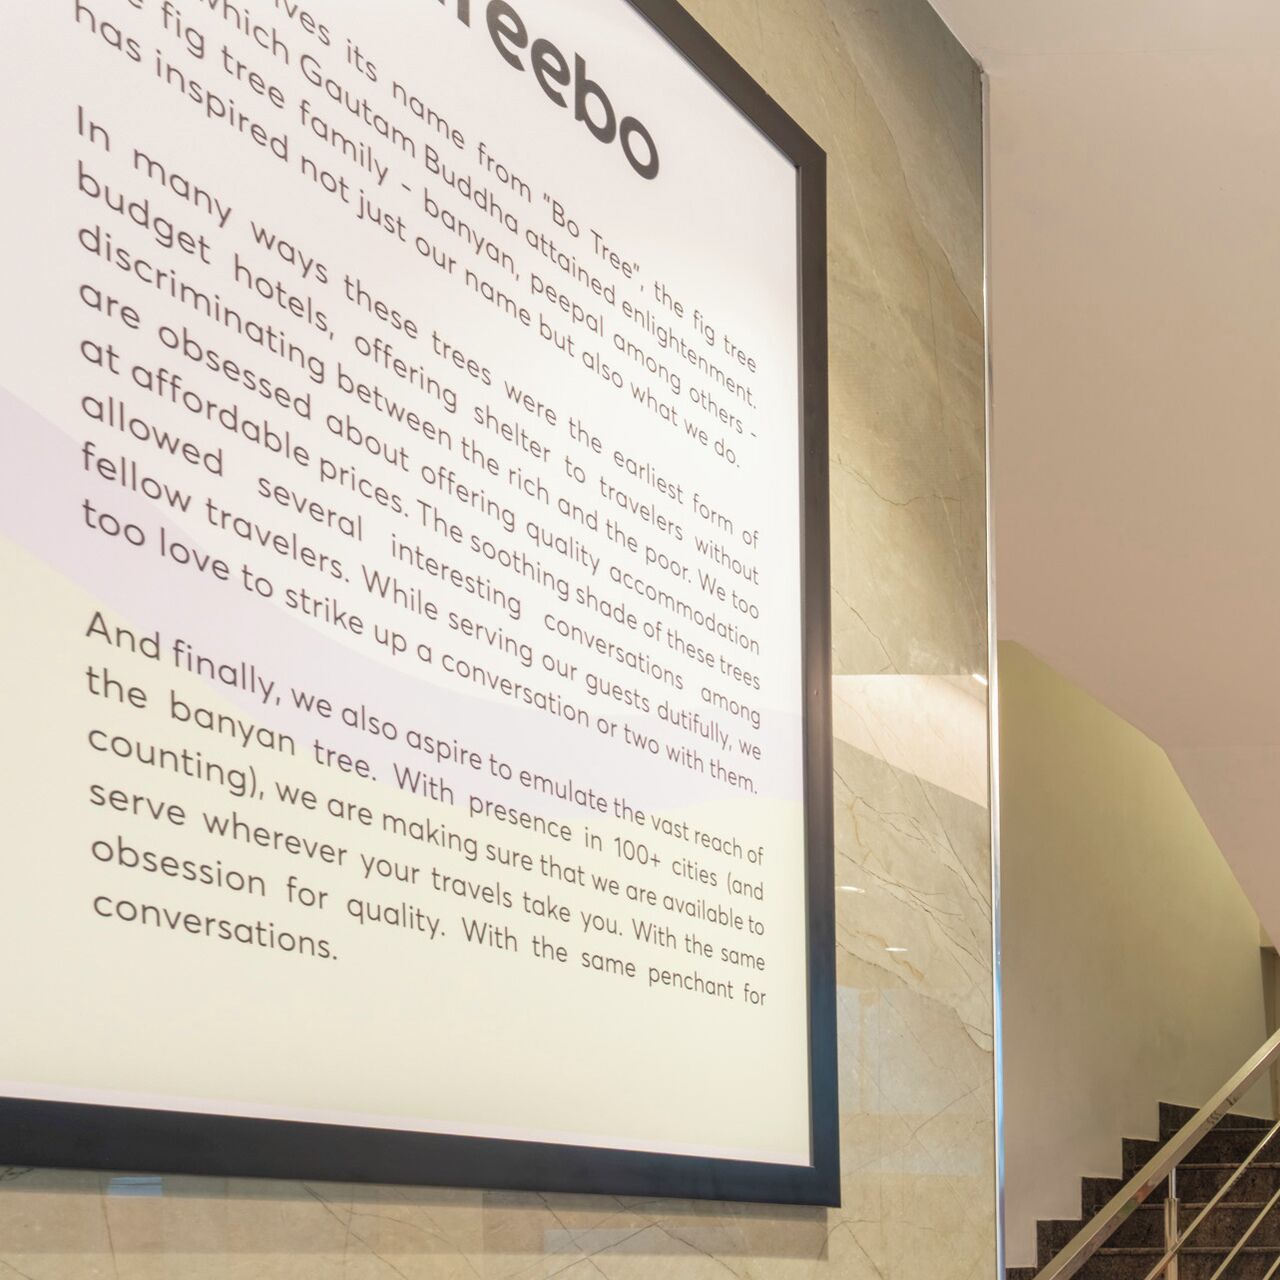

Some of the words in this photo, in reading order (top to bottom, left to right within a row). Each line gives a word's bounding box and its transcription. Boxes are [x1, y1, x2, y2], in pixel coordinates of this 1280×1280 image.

[75, 0, 141, 63] has
[156, 49, 288, 163] inspired
[301, 155, 350, 204] not
[356, 189, 406, 242] just
[415, 236, 457, 274] our
[465, 268, 531, 327] name
[539, 313, 575, 357] but
[582, 352, 623, 388] also
[630, 382, 678, 427] what
[684, 419, 708, 446] we
[714, 438, 739, 468] do.
[78, 105, 110, 152] In
[134, 149, 232, 228] many
[250, 221, 328, 284] ways
[344, 274, 418, 339] these
[432, 330, 491, 386] trees
[504, 380, 557, 426] were
[569, 417, 602, 454] the
[614, 451, 683, 504] earliest
[693, 493, 733, 535] form
[742, 530, 759, 549] of
[78, 160, 211, 265] budget
[234, 252, 334, 341] hotels,
[355, 336, 457, 414] offering
[474, 405, 551, 462] shelter
[565, 455, 586, 483] to
[600, 476, 683, 541] travelers
[695, 536, 759, 585] without
[78, 225, 325, 384] discriminating
[337, 362, 451, 451] between
[461, 436, 499, 476] the
[509, 468, 549, 505] rich
[558, 498, 598, 532] and
[605, 519, 638, 553] the
[646, 545, 691, 583] poor.
[698, 569, 726, 601] We
[731, 590, 759, 619] too
[79, 284, 141, 330] are
[158, 326, 311, 420] obsessed
[326, 414, 409, 472] about
[421, 466, 515, 533] offering
[526, 522, 600, 576] quality
[610, 566, 759, 655] accommodation
[80, 340, 120, 375] at
[131, 365, 310, 467] affordable
[320, 457, 408, 517] prices.
[416, 499, 463, 543] The
[470, 535, 569, 602] soothing
[576, 585, 637, 630] shade
[643, 621, 662, 641] of
[667, 628, 715, 668] these
[720, 655, 760, 690] trees
[81, 396, 223, 477] allowed
[258, 477, 362, 541] several
[392, 533, 521, 620] interesting
[544, 614, 683, 690] conversations
[701, 687, 760, 730] among
[81, 441, 192, 512] fellow
[205, 497, 349, 583] travelers.
[361, 564, 438, 620] While
[448, 612, 533, 668] serving
[542, 654, 578, 680] our
[585, 673, 650, 713] guests
[657, 700, 732, 751] dutifully,
[739, 739, 761, 760] we
[81, 498, 145, 546] too
[160, 526, 230, 581] love
[241, 564, 274, 598] to
[285, 588, 364, 635] strike
[374, 624, 407, 656] up
[417, 644, 432, 664] a
[442, 654, 589, 728] conversation
[597, 718, 618, 737] or
[624, 723, 659, 754] two
[666, 745, 704, 773] with
[709, 758, 757, 794] them.
[85, 611, 160, 661] And
[172, 639, 280, 706] finally,
[291, 688, 332, 718] we
[341, 705, 398, 740] also
[406, 730, 482, 770] aspire
[489, 753, 512, 780] to
[519, 770, 608, 813] emulate
[613, 797, 645, 826] the
[651, 815, 689, 841] vast
[694, 830, 742, 859] reach
[747, 846, 764, 866] of
[85, 666, 147, 709] the
[170, 689, 295, 756] banyan
[313, 739, 376, 781] tree.
[393, 763, 454, 806] With
[469, 795, 572, 842] presence
[585, 826, 602, 852] in
[614, 837, 661, 867] 100+
[672, 858, 717, 886] cities
[727, 872, 763, 901] (and
[88, 730, 264, 800] counting),
[275, 782, 317, 810] we
[327, 798, 373, 826] are
[383, 813, 478, 862] making
[486, 844, 533, 871] sure
[540, 854, 585, 887] that
[591, 874, 620, 895] we
[626, 885, 657, 906] are
[663, 896, 743, 930] available
[748, 915, 764, 936] to
[90, 784, 186, 826] serve
[202, 811, 348, 866] wherever
[360, 853, 420, 884] your
[431, 867, 512, 908] travels
[522, 891, 571, 923] take
[580, 911, 622, 936] you.
[632, 918, 676, 949] With
[684, 933, 713, 958] the
[721, 948, 765, 971] same
[91, 835, 265, 896] obsession
[286, 876, 328, 909] for
[347, 899, 445, 940] quality.
[461, 917, 518, 952] With
[532, 935, 568, 962] the
[581, 952, 636, 978] same
[649, 967, 734, 999] penchant
[744, 983, 766, 1006] for
[93, 896, 337, 960] conversations.
